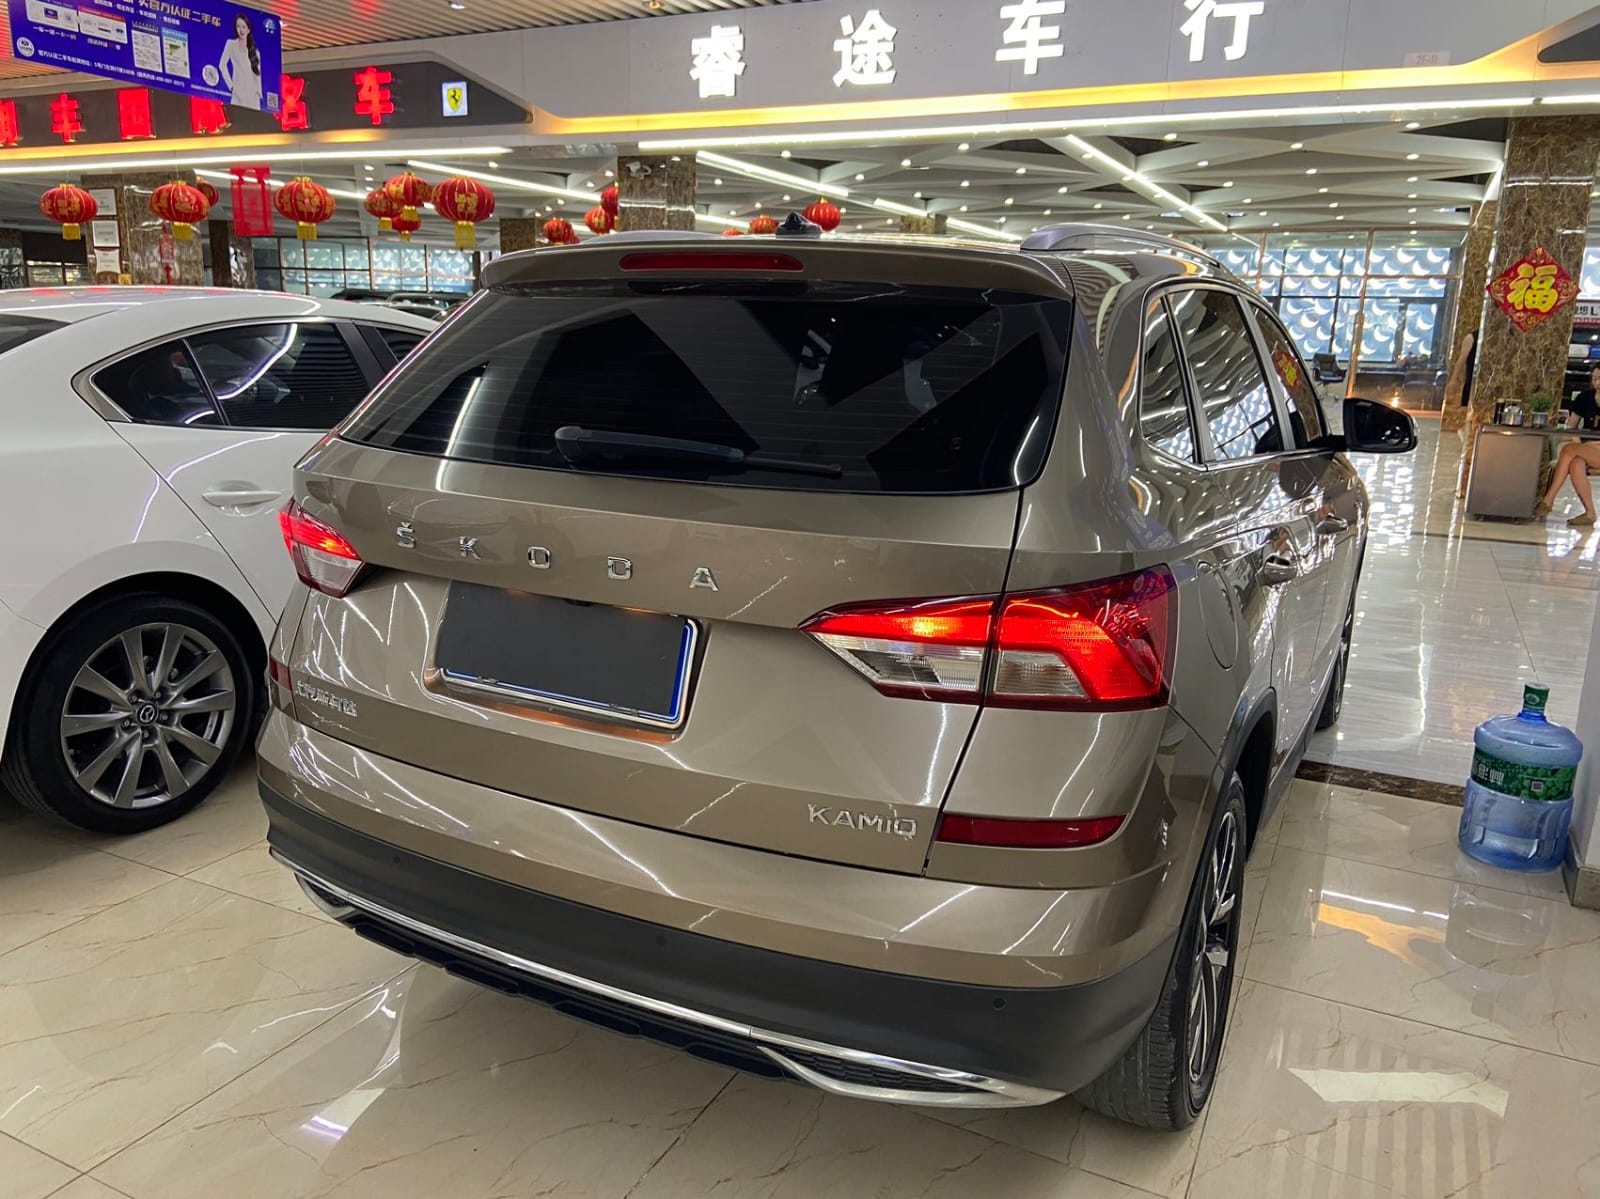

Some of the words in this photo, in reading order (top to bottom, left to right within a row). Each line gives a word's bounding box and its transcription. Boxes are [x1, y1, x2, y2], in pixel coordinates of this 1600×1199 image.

[690, 0, 1265, 98] 睿途车行
[1506, 263, 1559, 313] 福
[807, 803, 917, 840] KAMIQ
